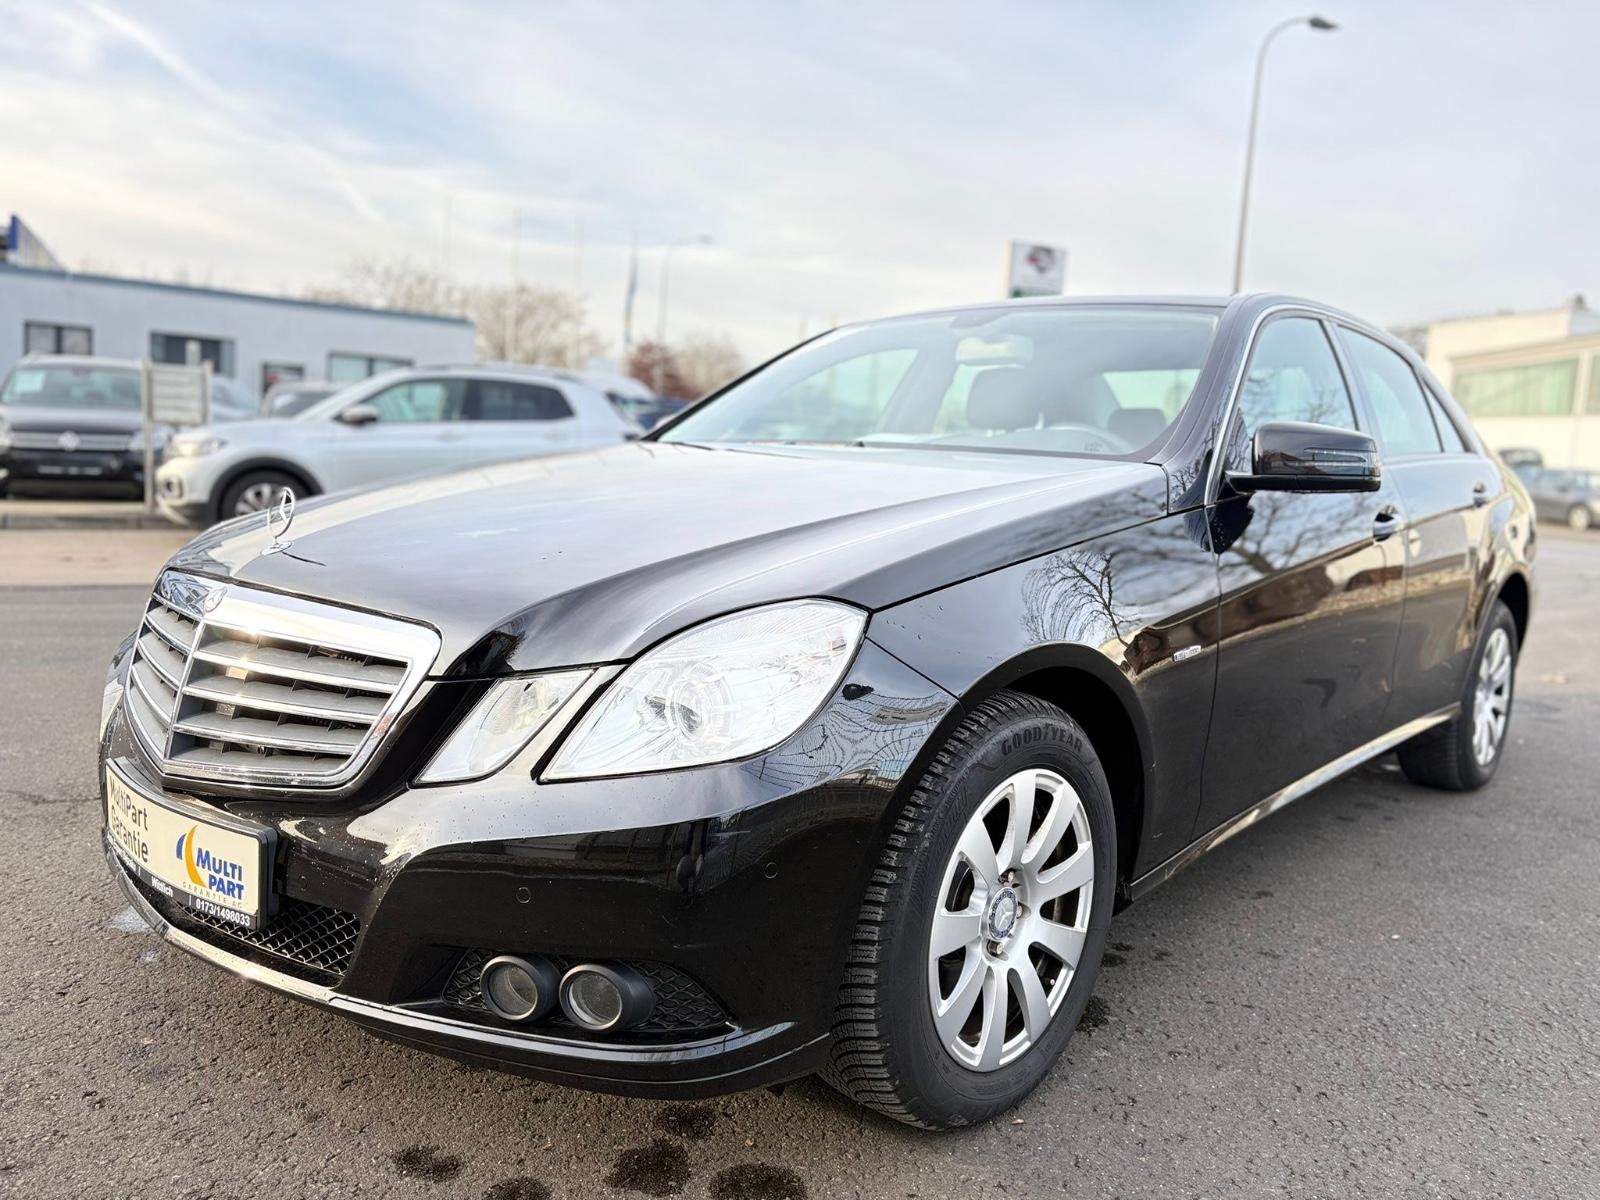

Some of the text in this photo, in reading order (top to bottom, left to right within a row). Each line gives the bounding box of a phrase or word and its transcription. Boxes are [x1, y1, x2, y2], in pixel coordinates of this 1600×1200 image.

[1001, 723, 1083, 756] GOODYEAR
[111, 804, 149, 863] Garantie
[182, 881, 227, 904] GARANTIE
[209, 874, 244, 900] PART
[195, 898, 251, 927] 0173/1498033
